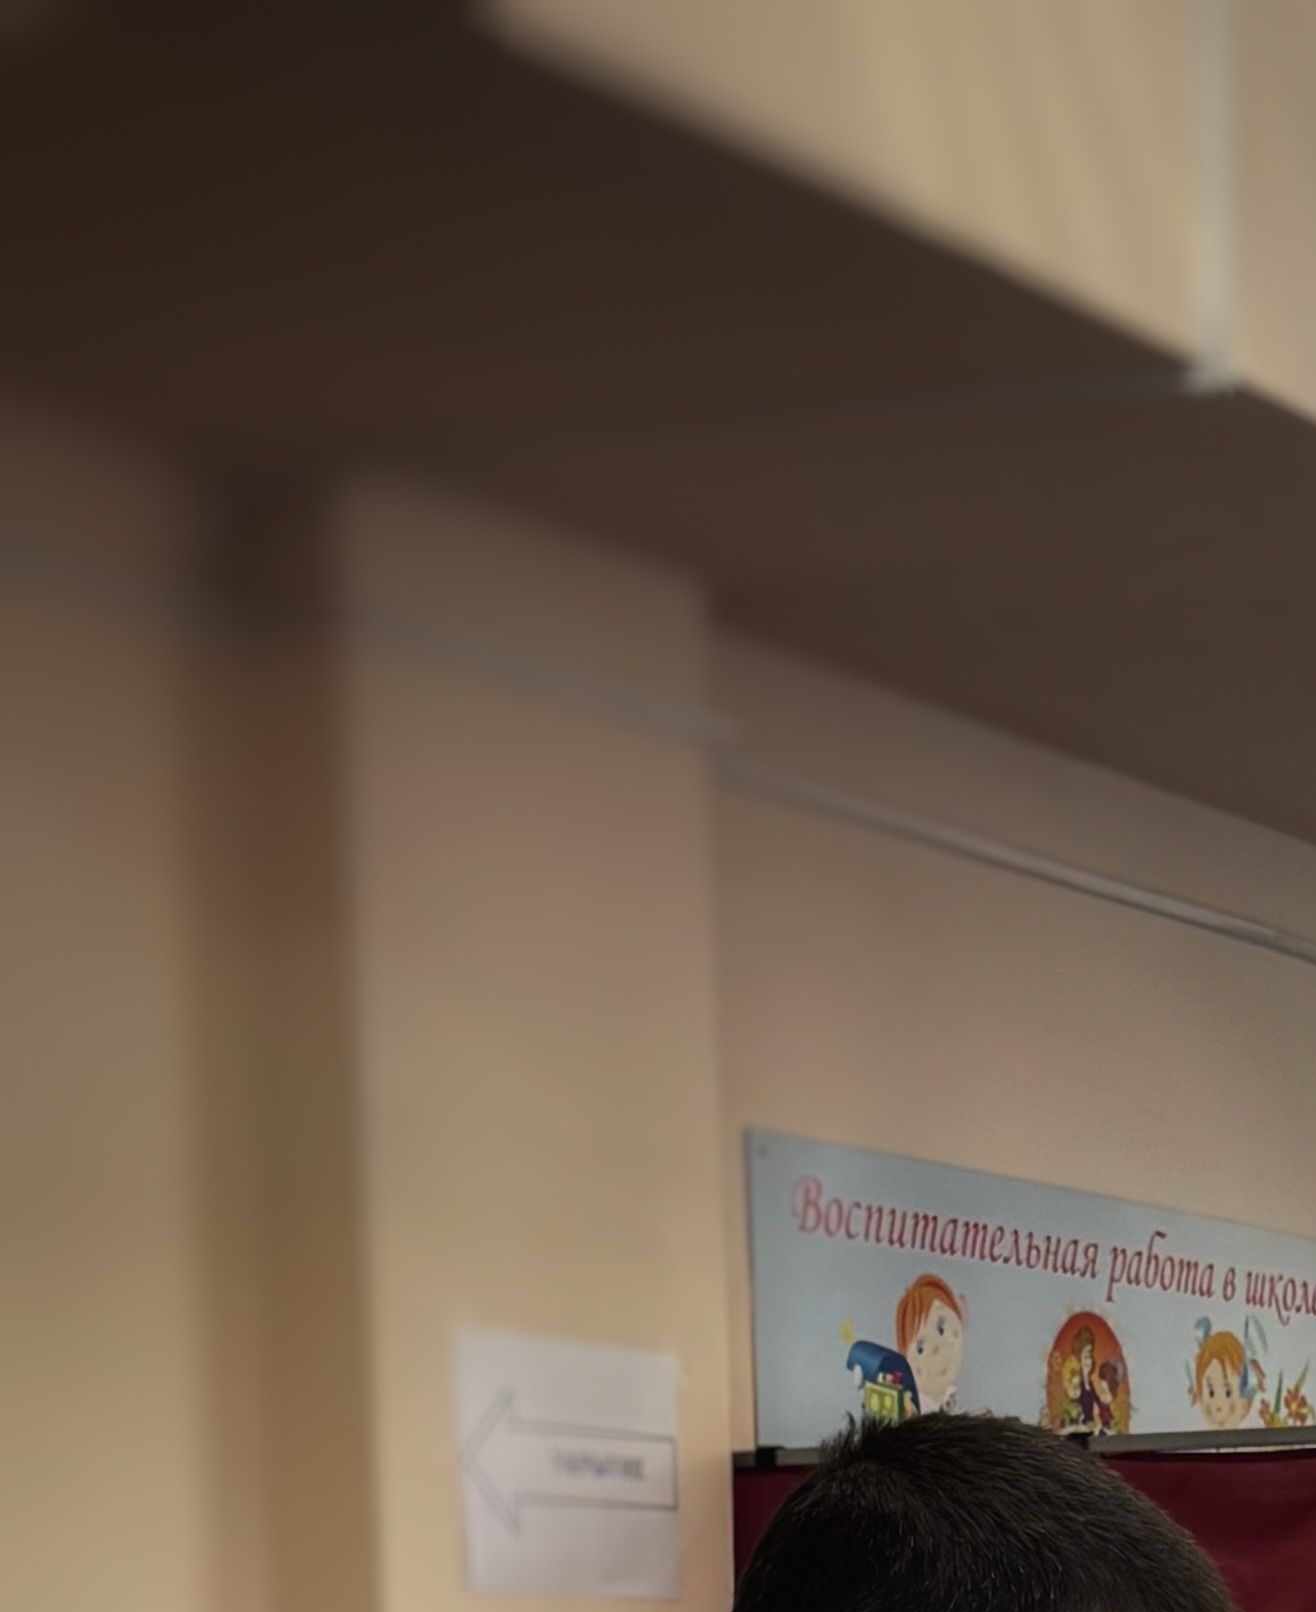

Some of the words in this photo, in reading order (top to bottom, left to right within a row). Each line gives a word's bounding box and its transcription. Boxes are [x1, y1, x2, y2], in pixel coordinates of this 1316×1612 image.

[791, 1174, 1100, 1280] Воспитательная
[1105, 1230, 1215, 1302] работа
[1222, 1266, 1237, 1302] в
